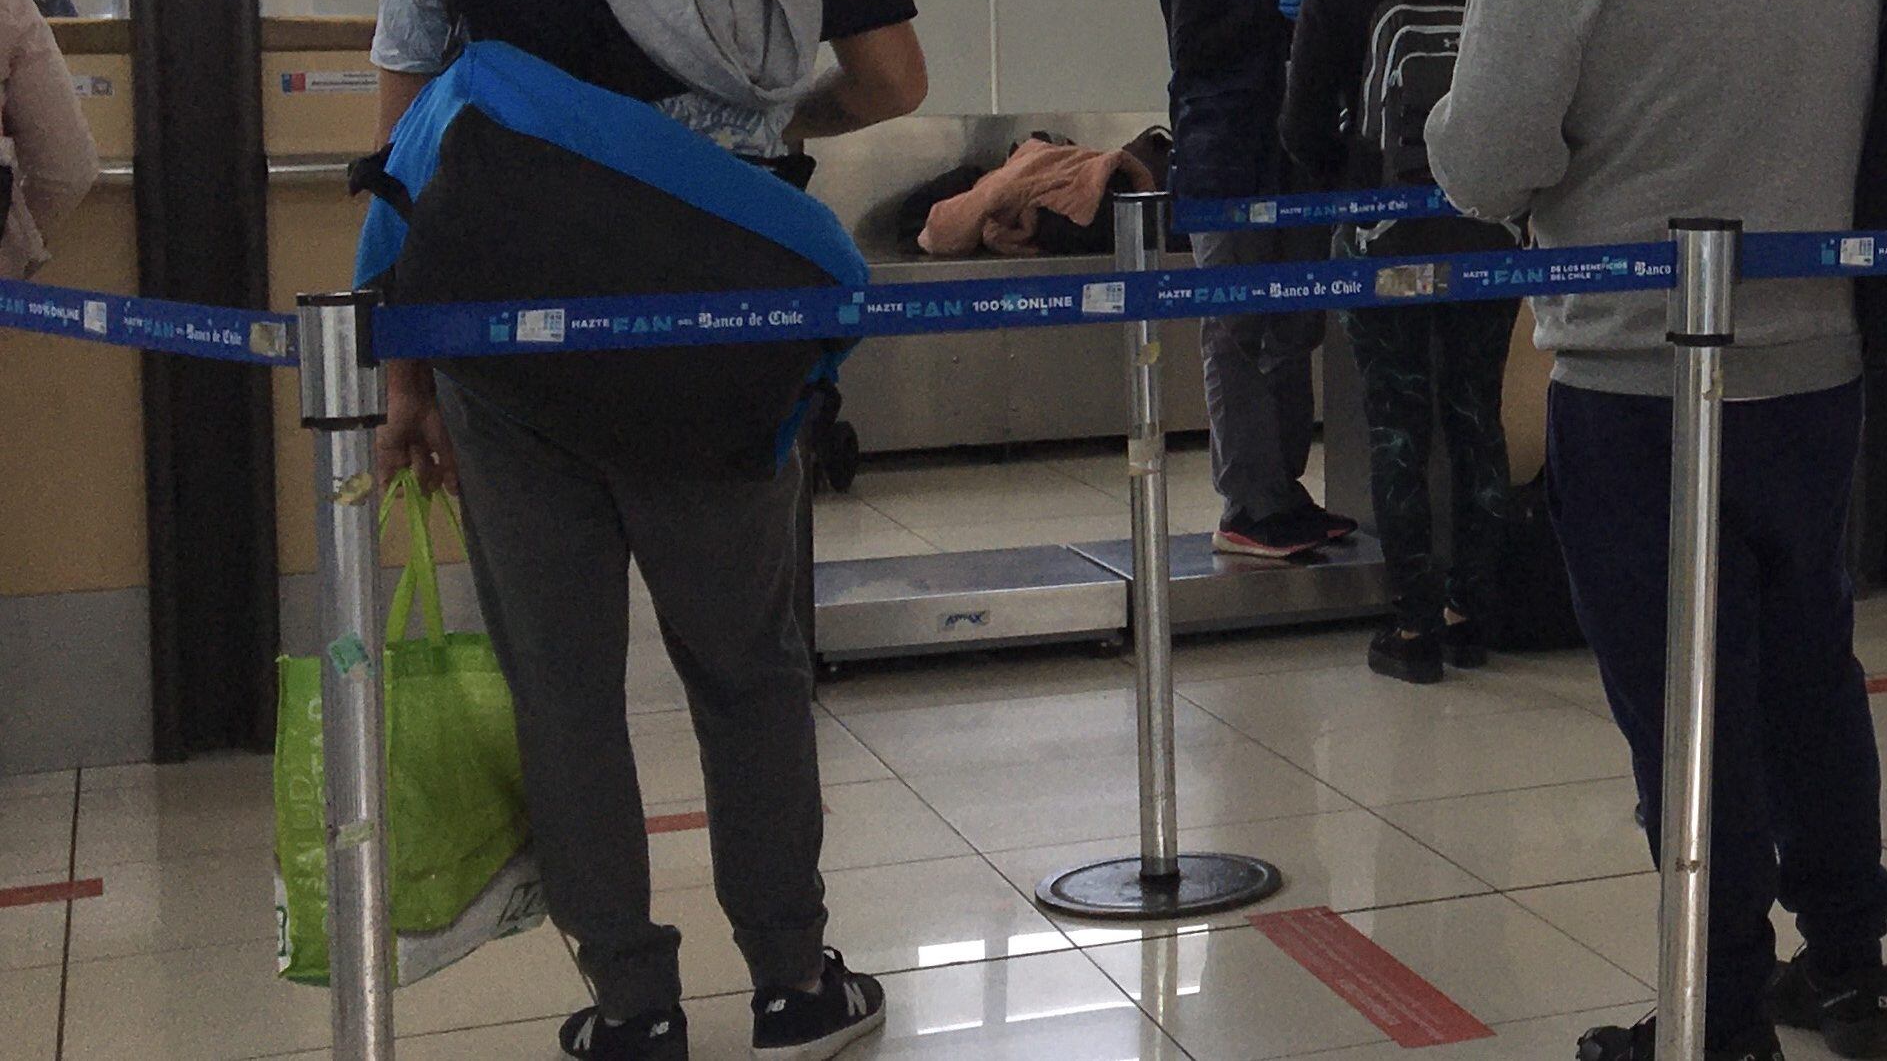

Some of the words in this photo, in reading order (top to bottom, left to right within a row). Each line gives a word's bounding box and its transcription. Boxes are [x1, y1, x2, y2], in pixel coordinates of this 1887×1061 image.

[1494, 269, 1543, 284] FAN
[1634, 261, 1672, 276] Banco
[1158, 289, 1192, 299] HAZTE
[1194, 286, 1247, 302] FAN
[1269, 282, 1310, 297] Banco
[1313, 281, 1327, 295] de
[1331, 280, 1362, 294] Chile
[867, 302, 903, 313] HAZTE
[905, 299, 964, 318] FAN
[972, 300, 1015, 312] 100%
[1017, 296, 1073, 310] ONLINE
[571, 318, 611, 329] HAZTE
[613, 315, 673, 334] FAN
[698, 312, 744, 328] Banco
[749, 311, 763, 326] de
[768, 310, 804, 326] Chile
